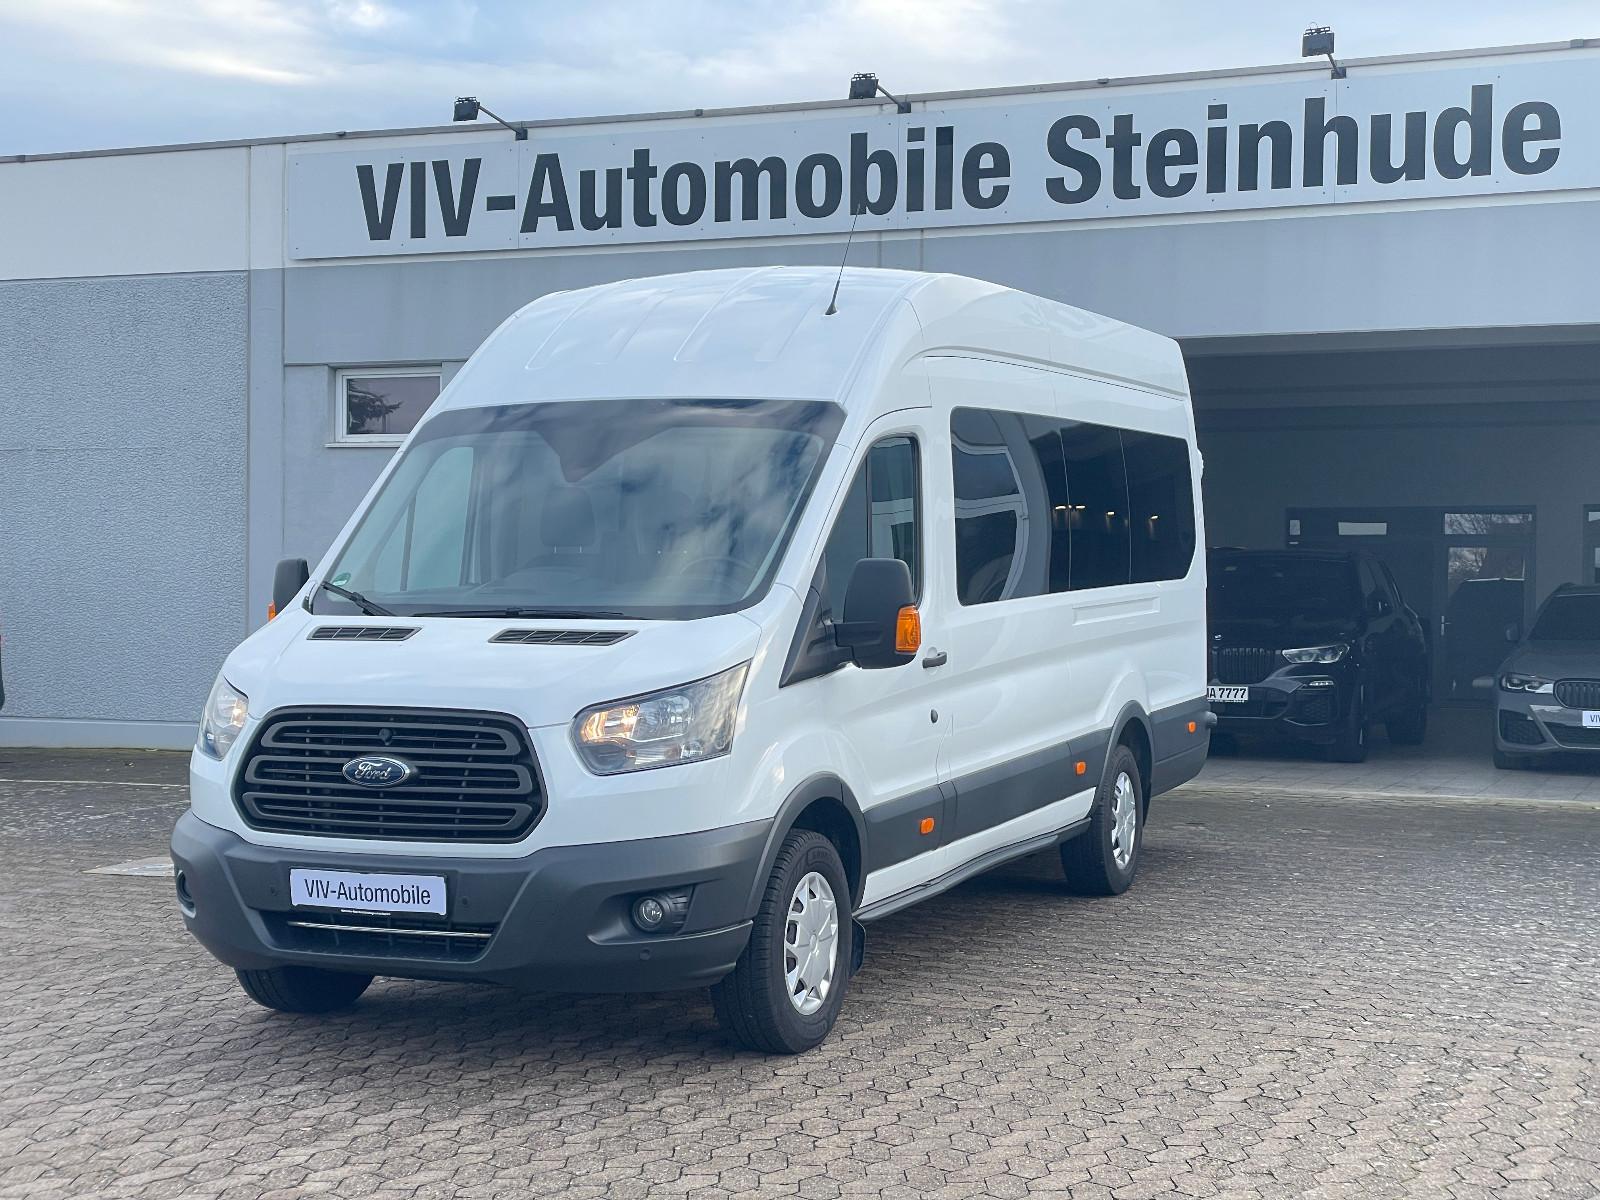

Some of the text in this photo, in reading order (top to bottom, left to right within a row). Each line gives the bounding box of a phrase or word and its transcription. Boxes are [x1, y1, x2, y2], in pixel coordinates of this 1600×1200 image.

[355, 83, 1562, 241] VIV-Automobile Steinhude
[1218, 687, 1247, 699] 7777
[354, 761, 391, 780] Ford
[303, 878, 431, 905] VIV-Automobile
